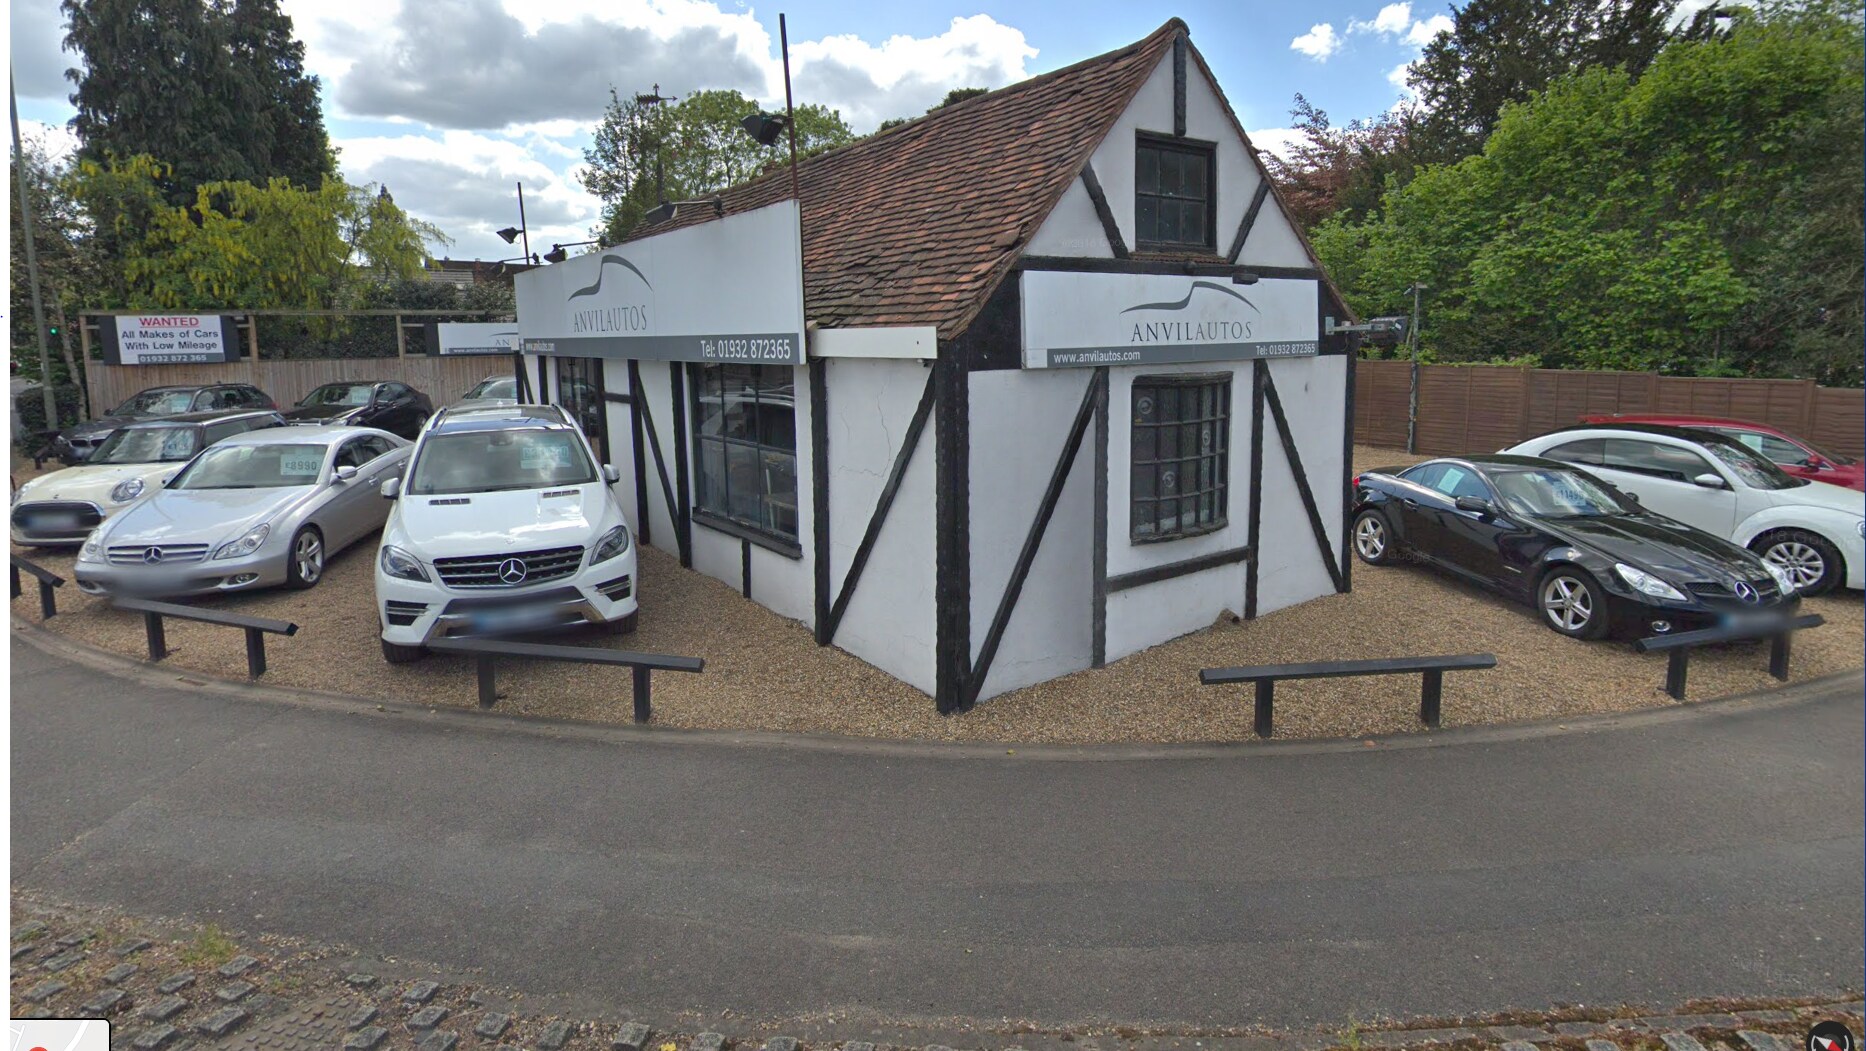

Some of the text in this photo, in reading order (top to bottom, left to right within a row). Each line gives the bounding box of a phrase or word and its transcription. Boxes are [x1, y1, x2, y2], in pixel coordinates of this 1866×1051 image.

[139, 317, 199, 326] WANTED
[573, 304, 648, 333] ANVILAUTOS
[121, 329, 219, 339] All Makes of Cars
[1131, 321, 1252, 342] ANVILAUTOS
[125, 341, 218, 351] With Low Mileage
[700, 339, 791, 359] Tel: 01932 872365
[1255, 343, 1316, 356] Tel: 01932 872365
[139, 355, 169, 363] 01932
[171, 354, 188, 362] 872
[1053, 350, 1141, 363] www.anvilautos.com
